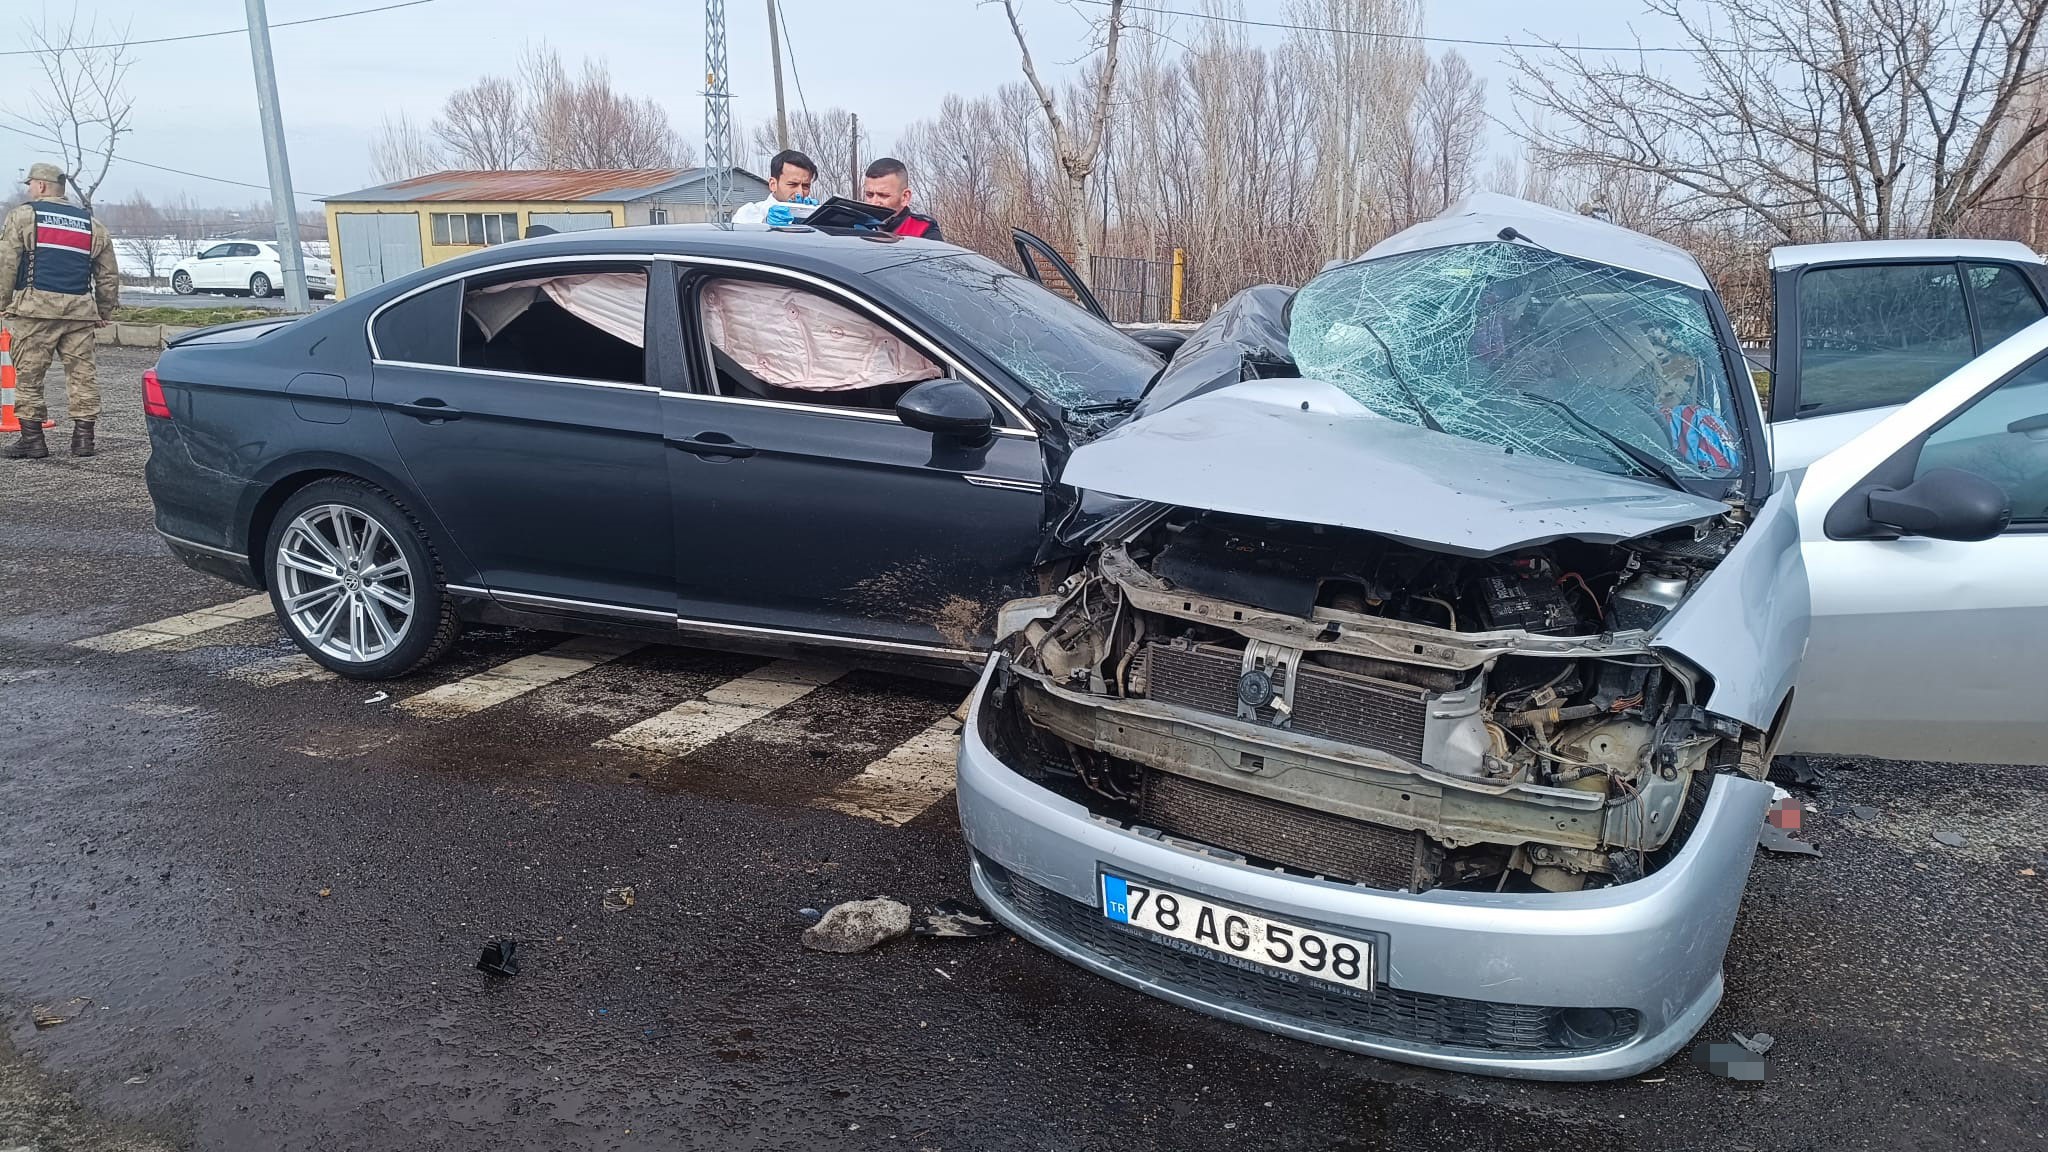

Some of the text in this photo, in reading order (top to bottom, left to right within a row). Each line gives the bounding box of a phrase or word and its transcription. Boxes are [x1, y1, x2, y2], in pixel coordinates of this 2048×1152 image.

[42, 215, 86, 230] JANDARMA
[1110, 901, 1126, 914] TR
[1126, 885, 1361, 980] 78 AG 598
[1151, 933, 1215, 960] MUSTAFA
[1268, 969, 1300, 984] OTO
